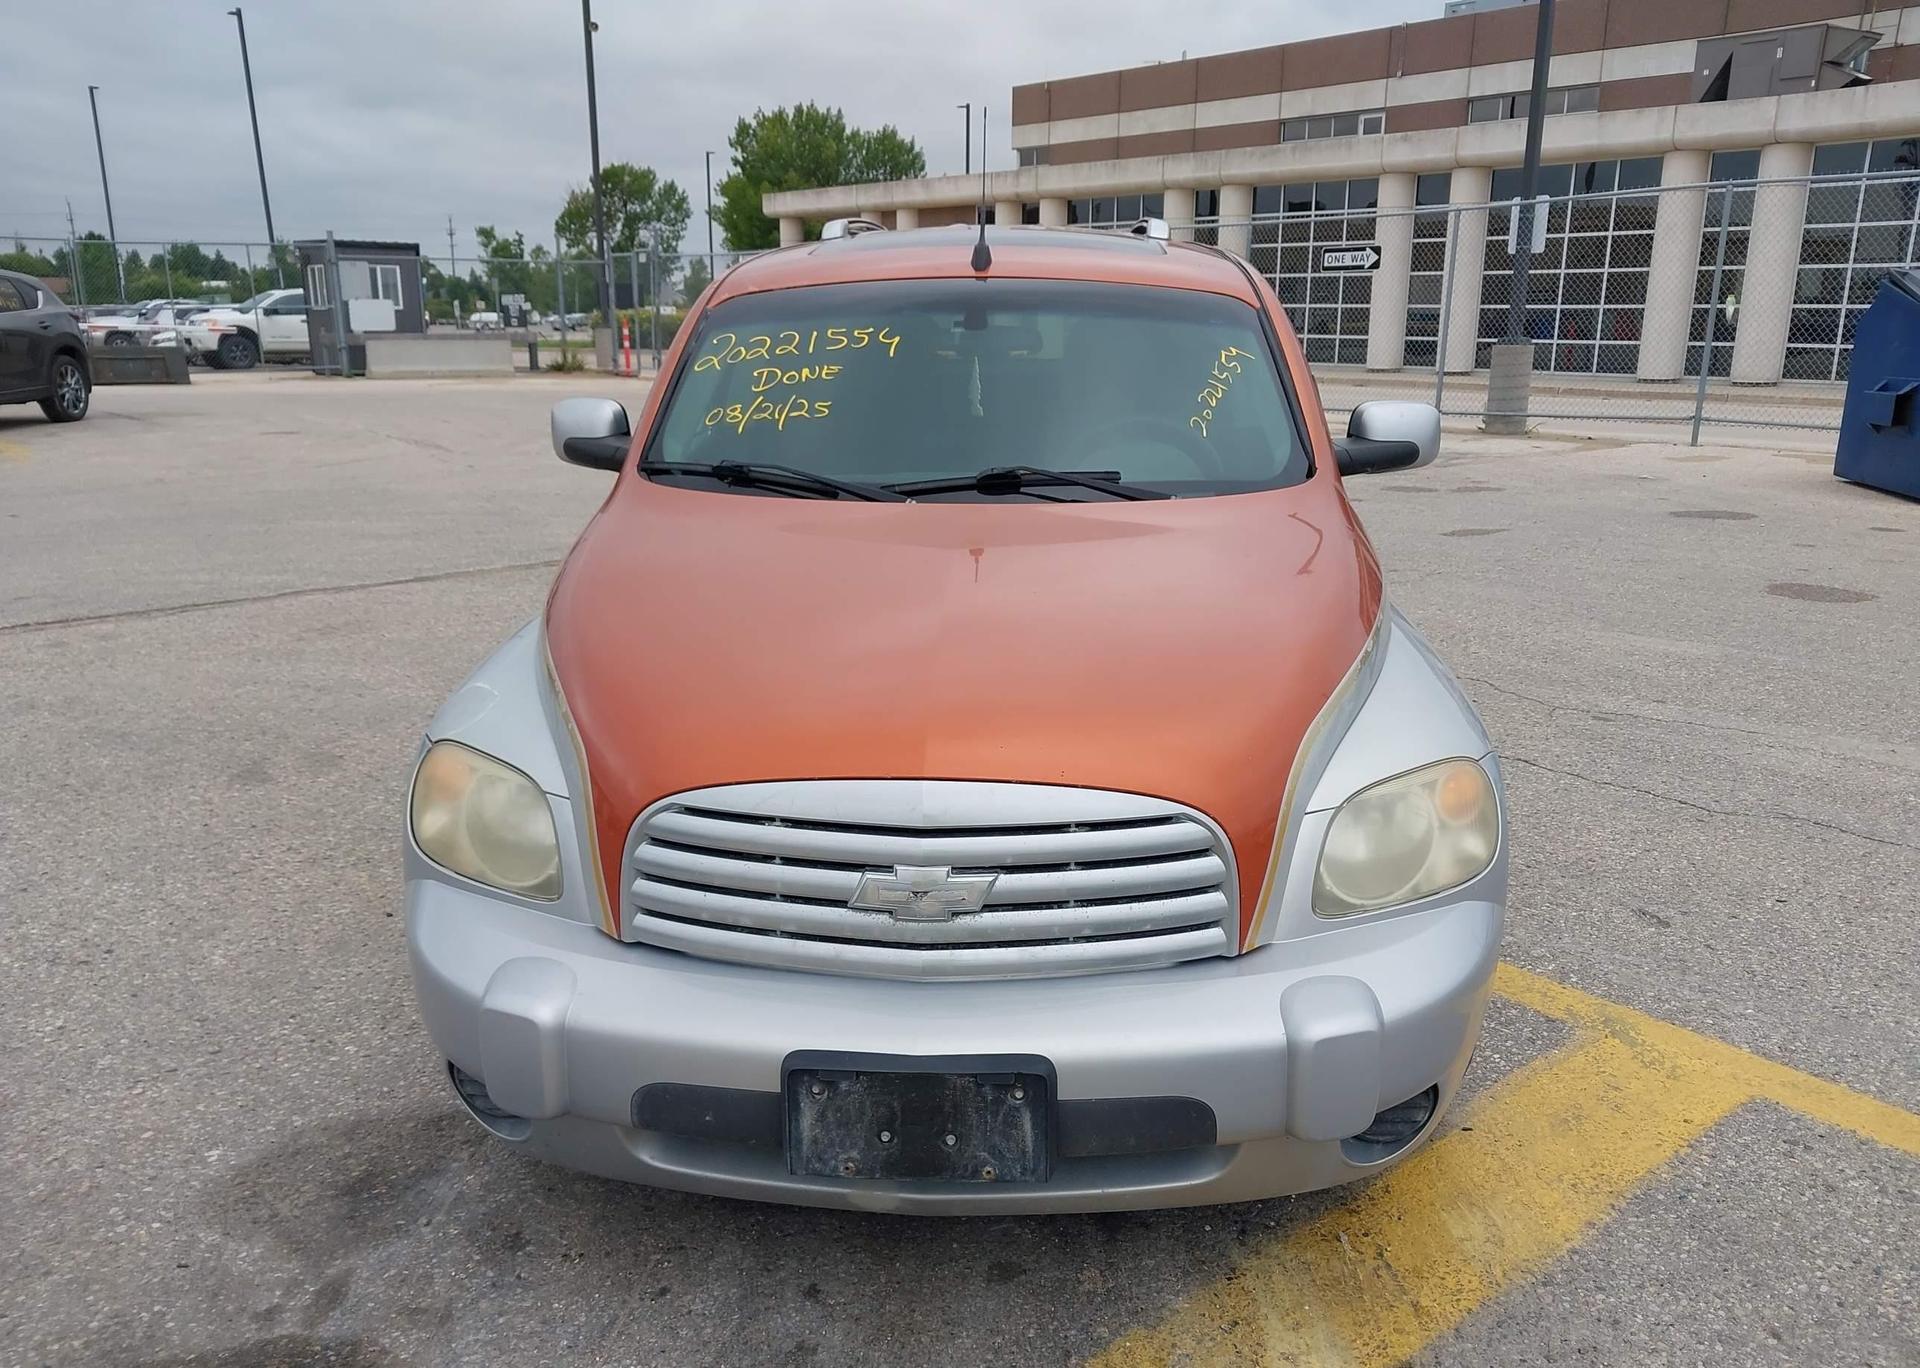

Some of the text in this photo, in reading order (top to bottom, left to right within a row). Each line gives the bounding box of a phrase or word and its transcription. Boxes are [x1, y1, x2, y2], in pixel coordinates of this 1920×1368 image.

[1326, 253, 1371, 264] ONE WAY
[751, 365, 843, 392] DONE
